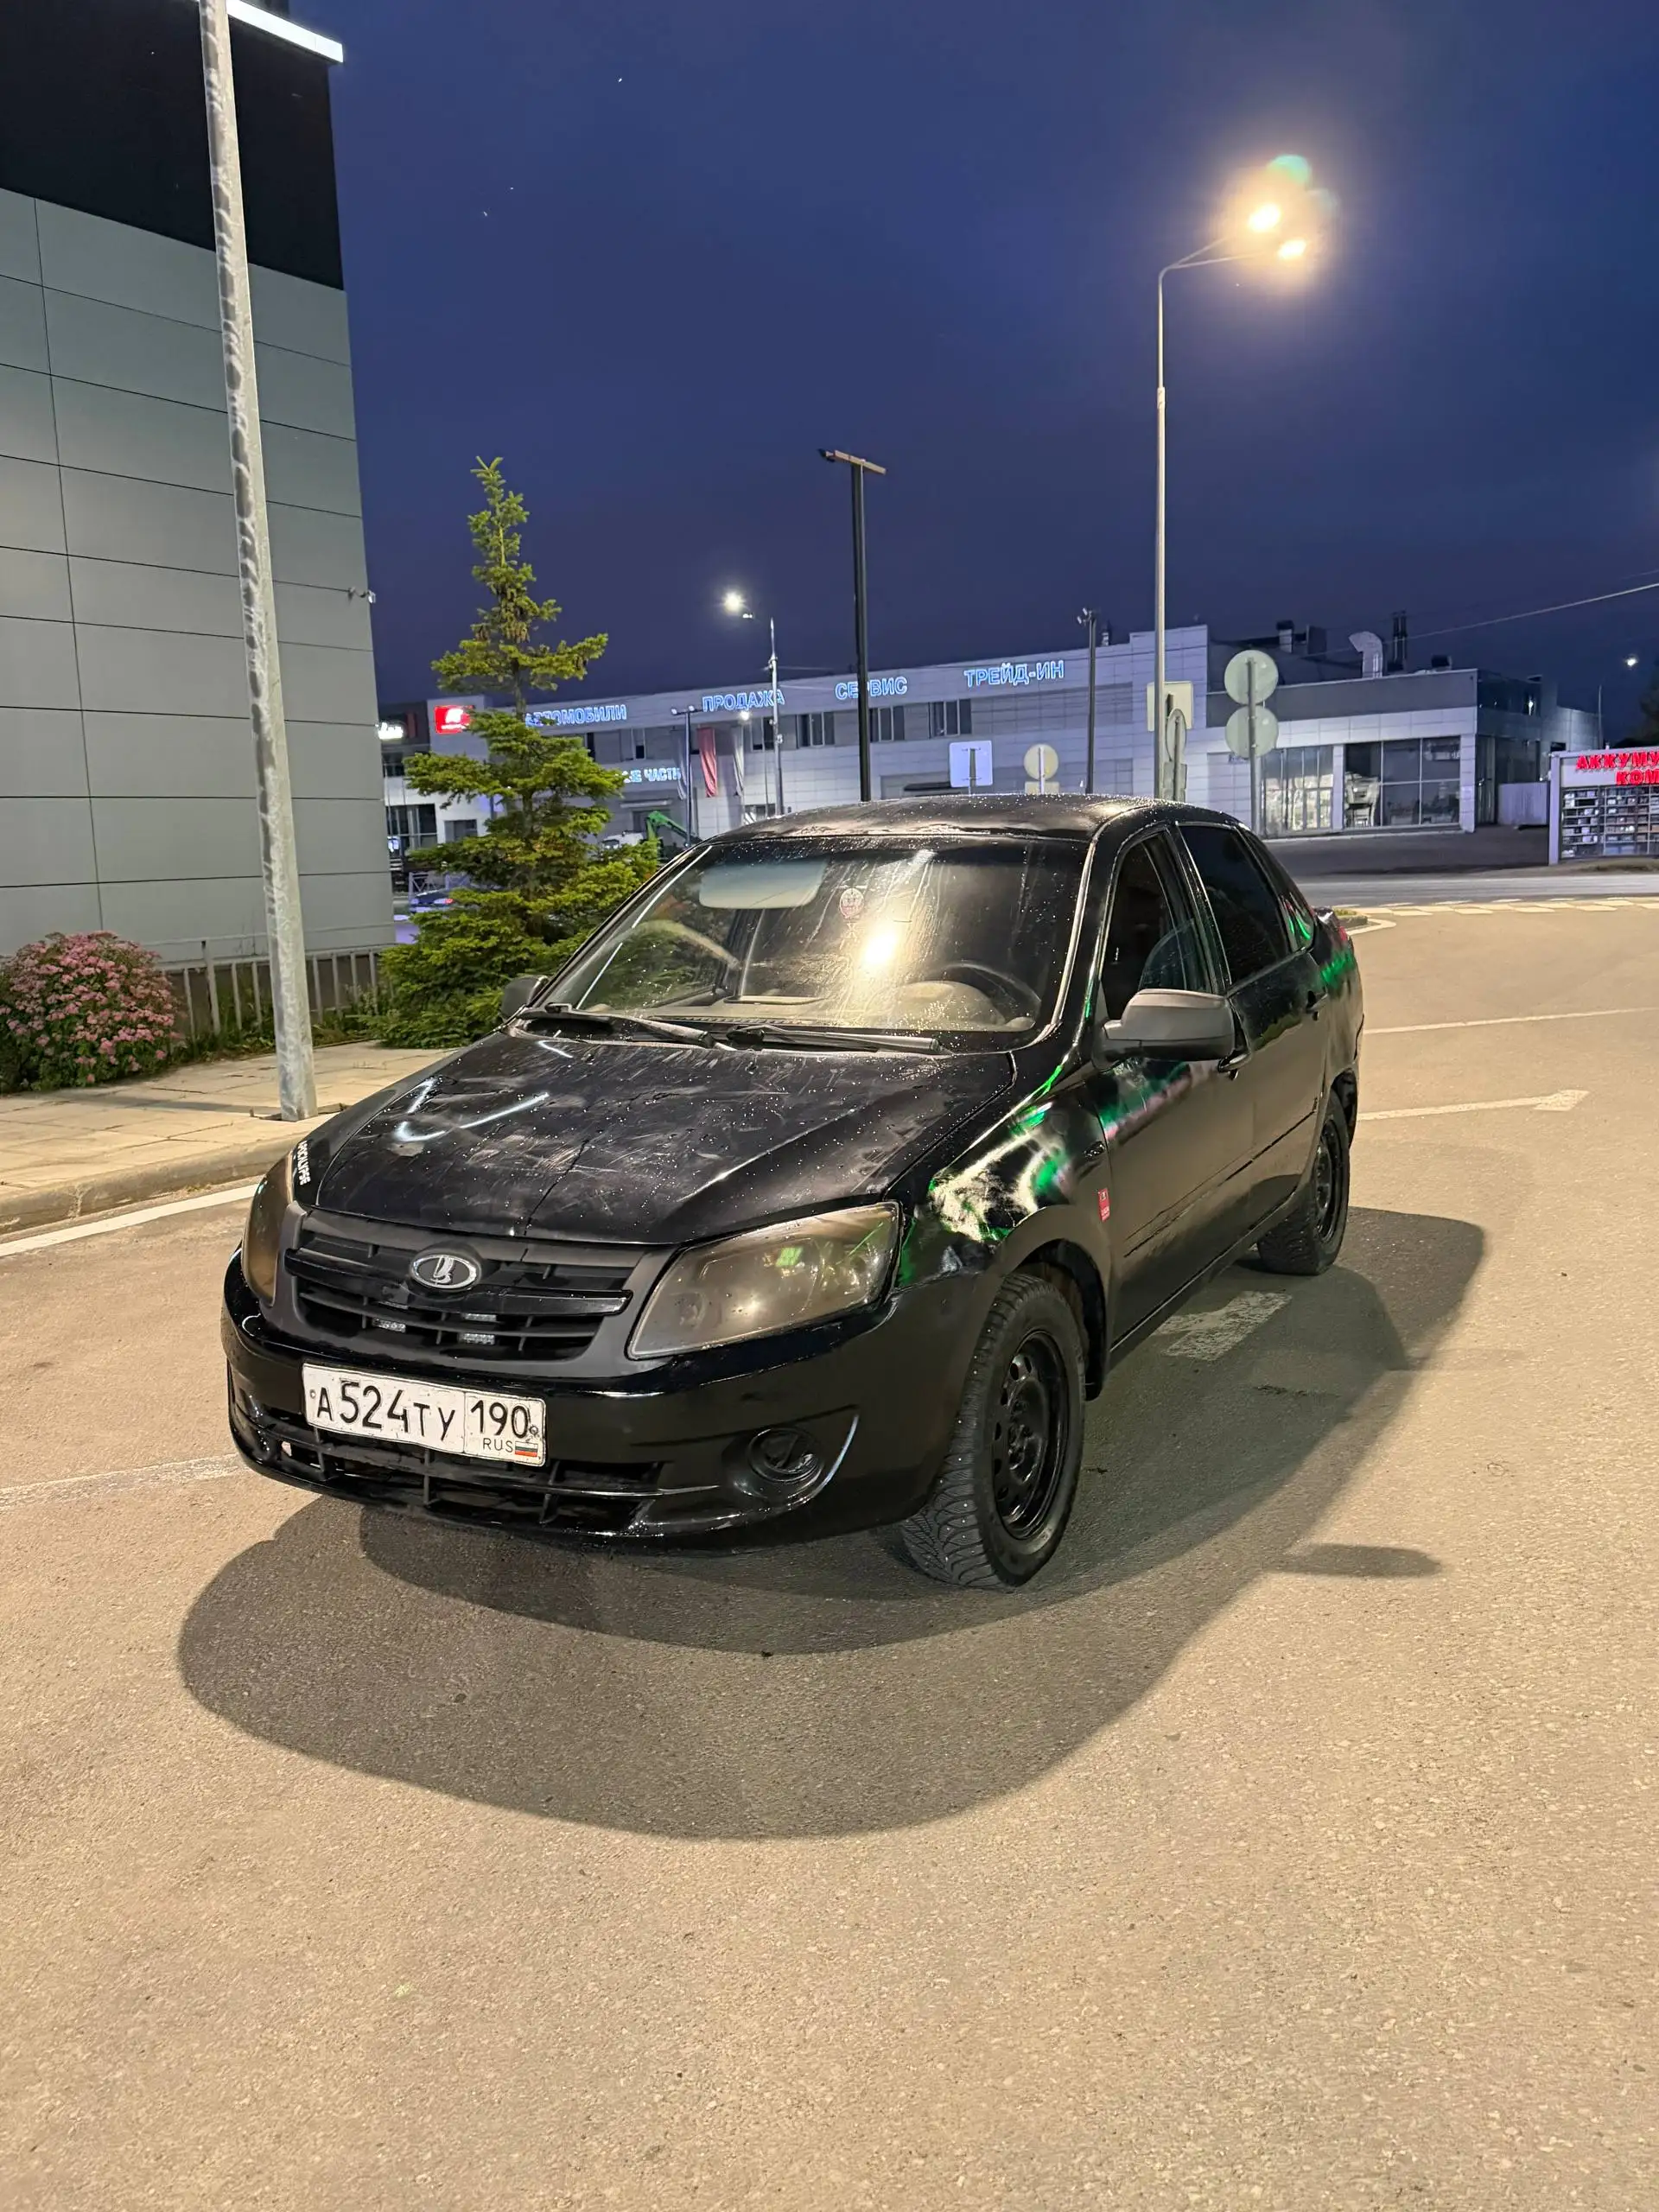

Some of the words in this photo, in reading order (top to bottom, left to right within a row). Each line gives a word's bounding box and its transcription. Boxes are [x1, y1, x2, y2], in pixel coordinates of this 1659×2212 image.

[963, 660, 1065, 688] ТРЕЙД-ИН
[835, 676, 908, 700] СЕВИС
[469, 1399, 531, 1439] 190
[481, 1437, 514, 1453] RUS
